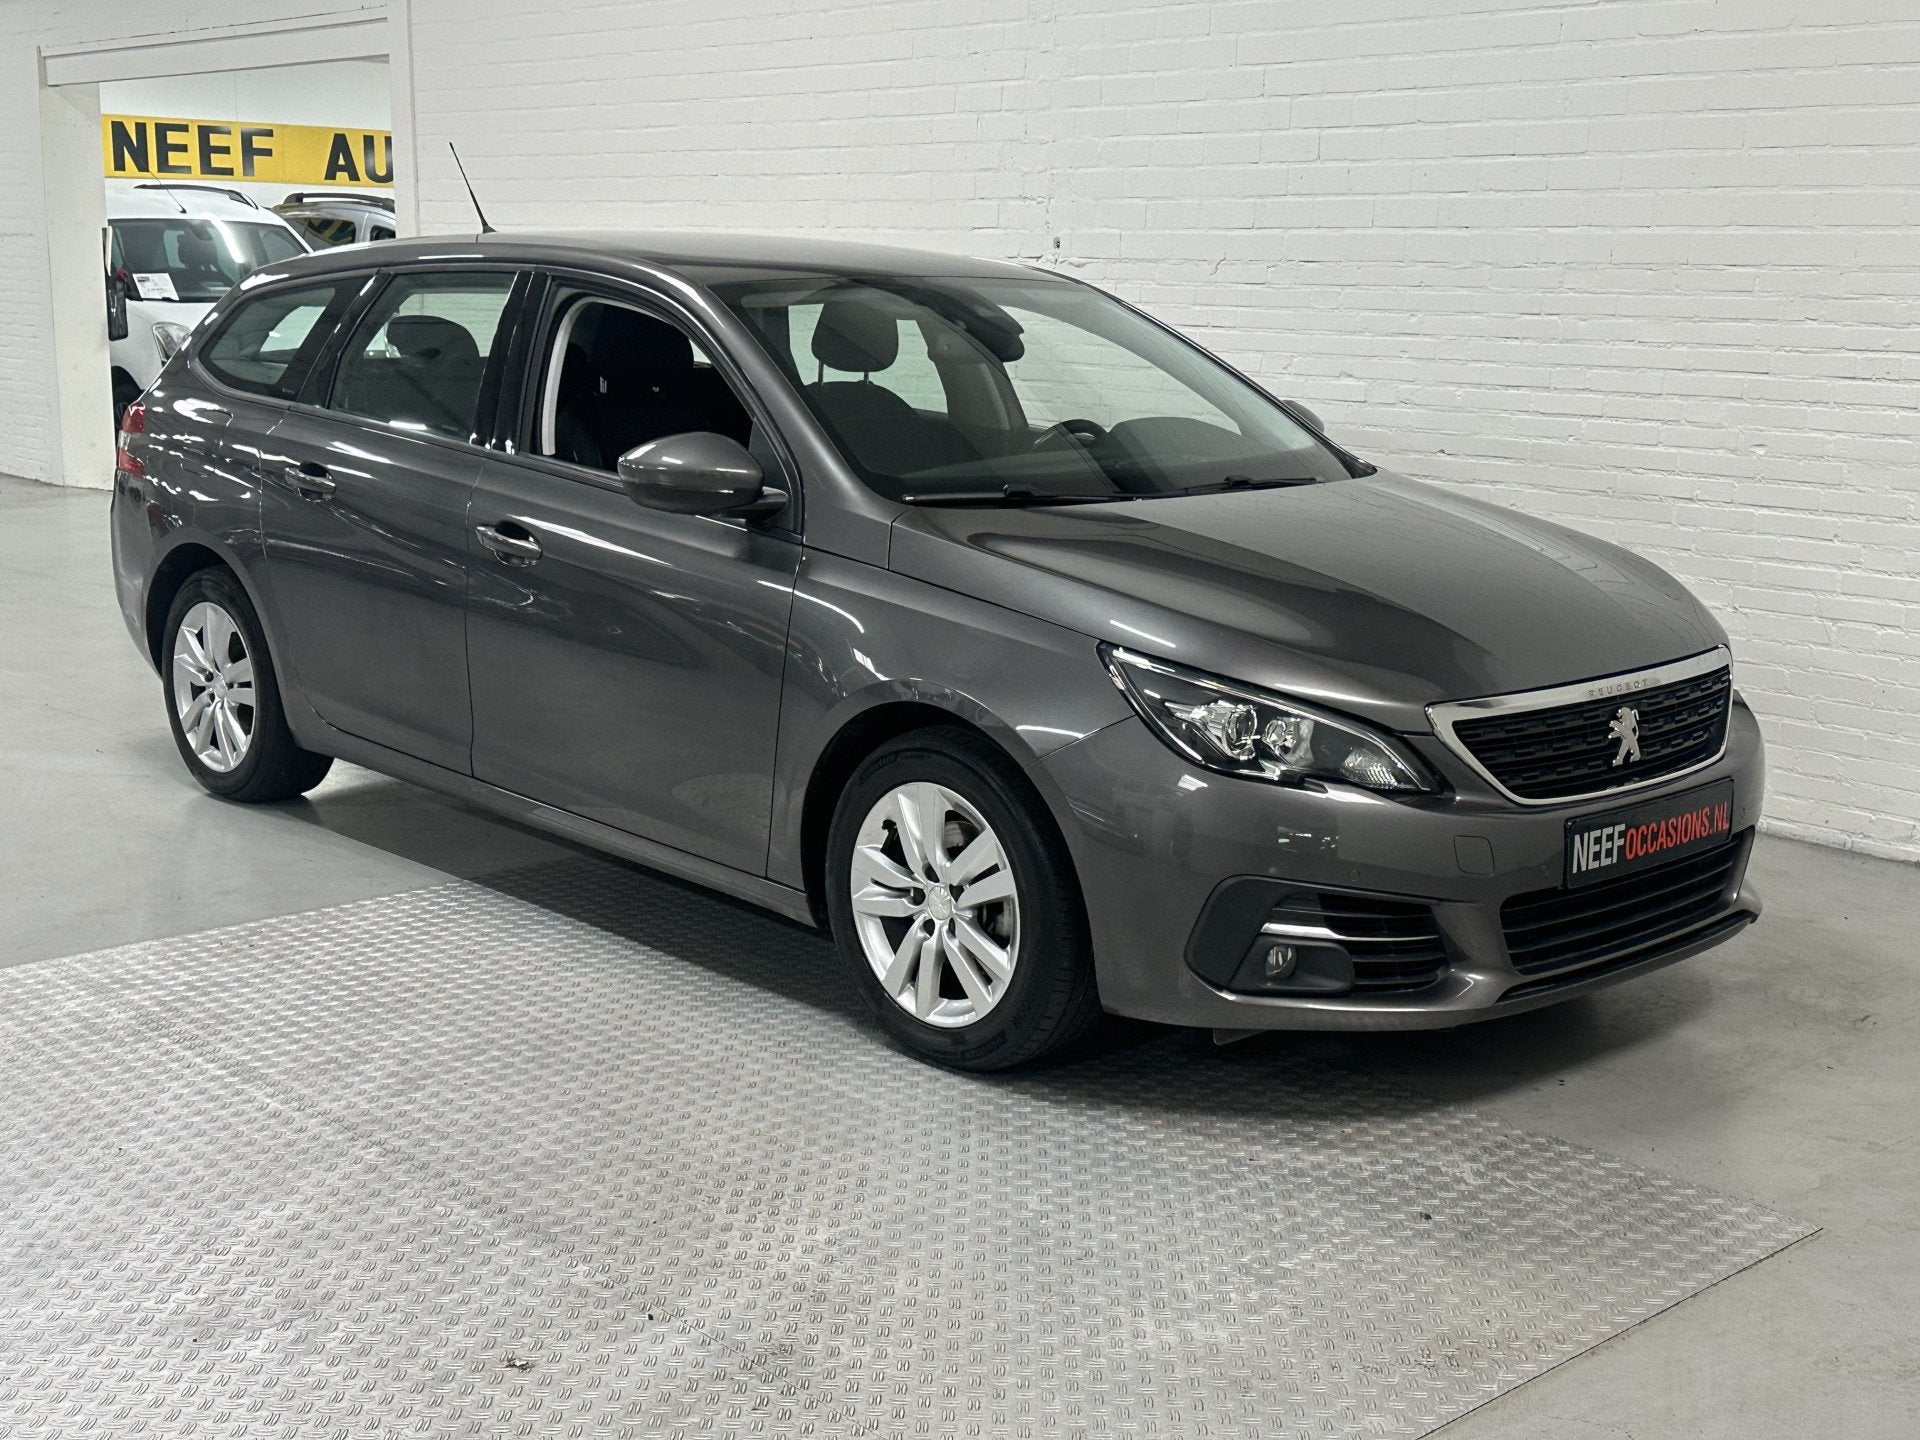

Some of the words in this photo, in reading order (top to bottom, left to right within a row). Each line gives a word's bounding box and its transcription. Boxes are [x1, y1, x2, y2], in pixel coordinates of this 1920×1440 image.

[111, 120, 275, 177] NEEF
[323, 133, 394, 183] AU
[1588, 678, 1648, 698] PEUGEOT
